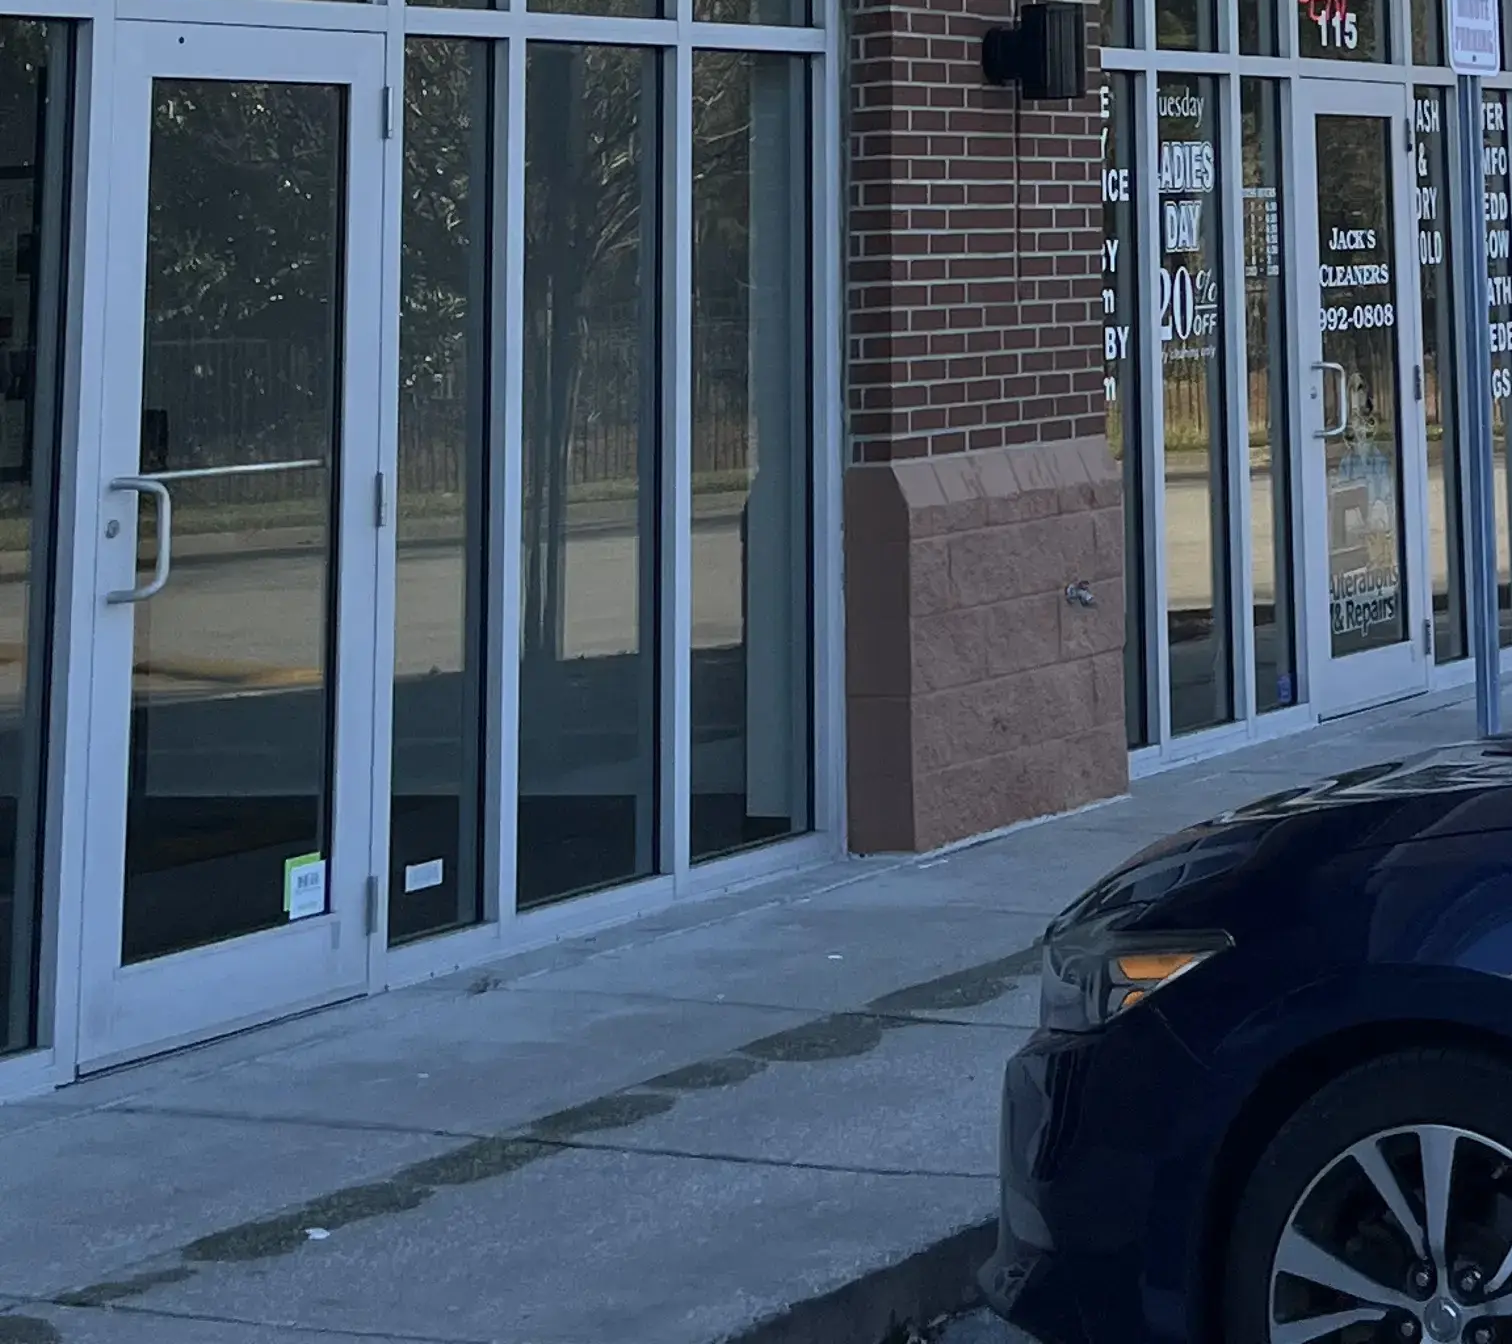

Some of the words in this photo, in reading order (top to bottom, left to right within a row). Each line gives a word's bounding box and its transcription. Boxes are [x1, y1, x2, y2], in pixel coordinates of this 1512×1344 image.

[1317, 10, 1358, 50] 115
[1157, 87, 1205, 128] uesday
[1415, 99, 1440, 133] ASH
[1158, 141, 1215, 193] ADIES
[1164, 200, 1202, 253] DAY
[1419, 230, 1443, 265] OLD
[1319, 263, 1390, 288] CLEANERS
[1193, 313, 1218, 337] OFF
[1492, 368, 1512, 398] GS
